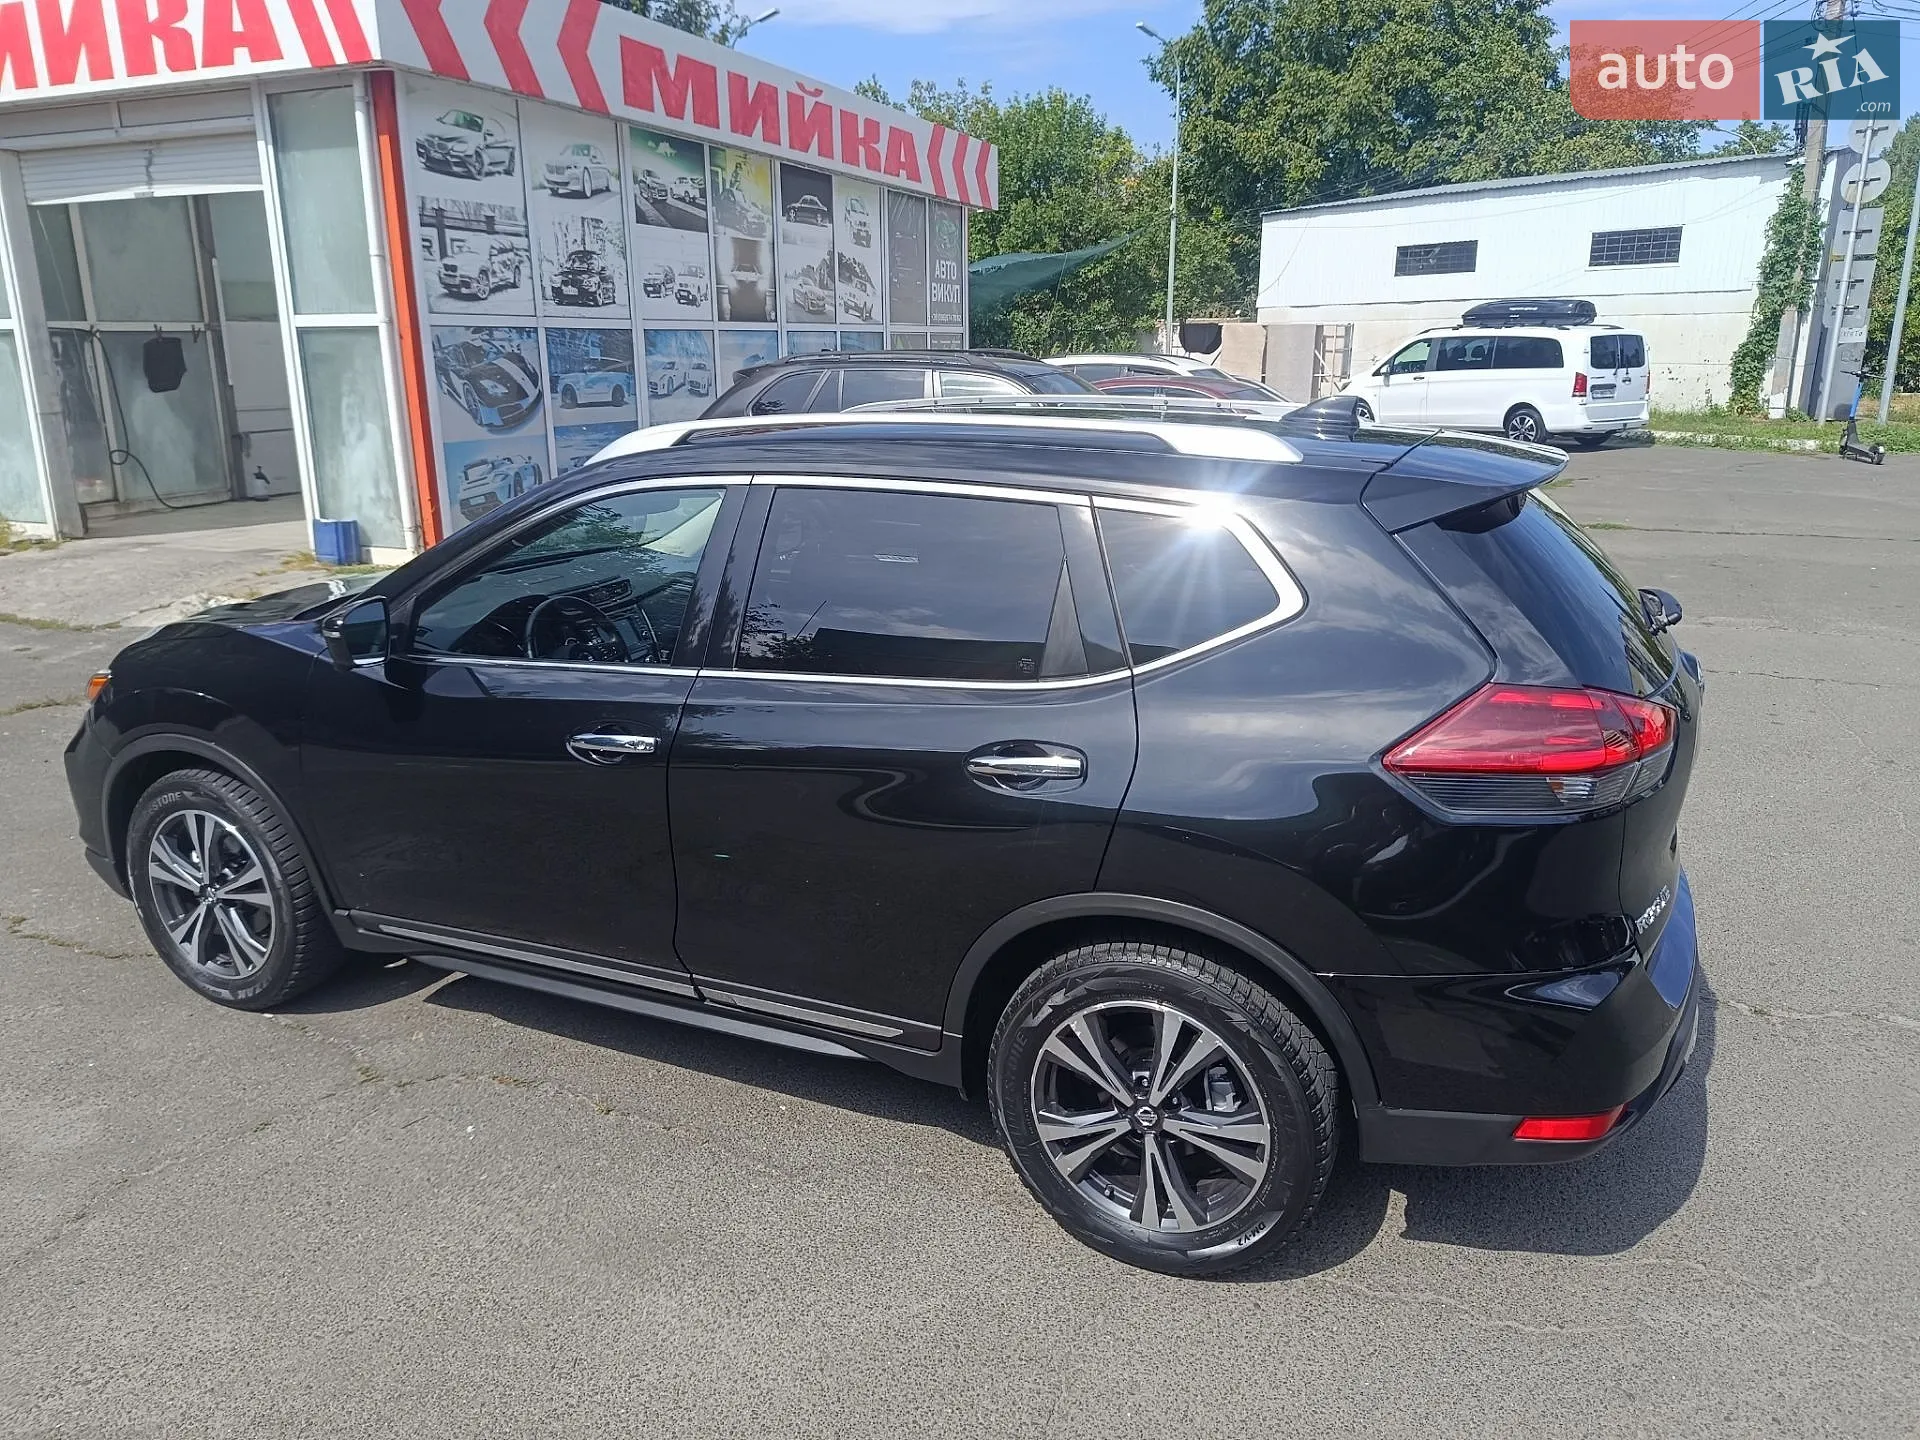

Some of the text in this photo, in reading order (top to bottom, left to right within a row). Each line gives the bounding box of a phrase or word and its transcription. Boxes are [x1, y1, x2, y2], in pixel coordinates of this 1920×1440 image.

[620, 34, 922, 184] МИЙКА
[934, 259, 957, 280] АВТО
[931, 282, 961, 303] ВИКУП
